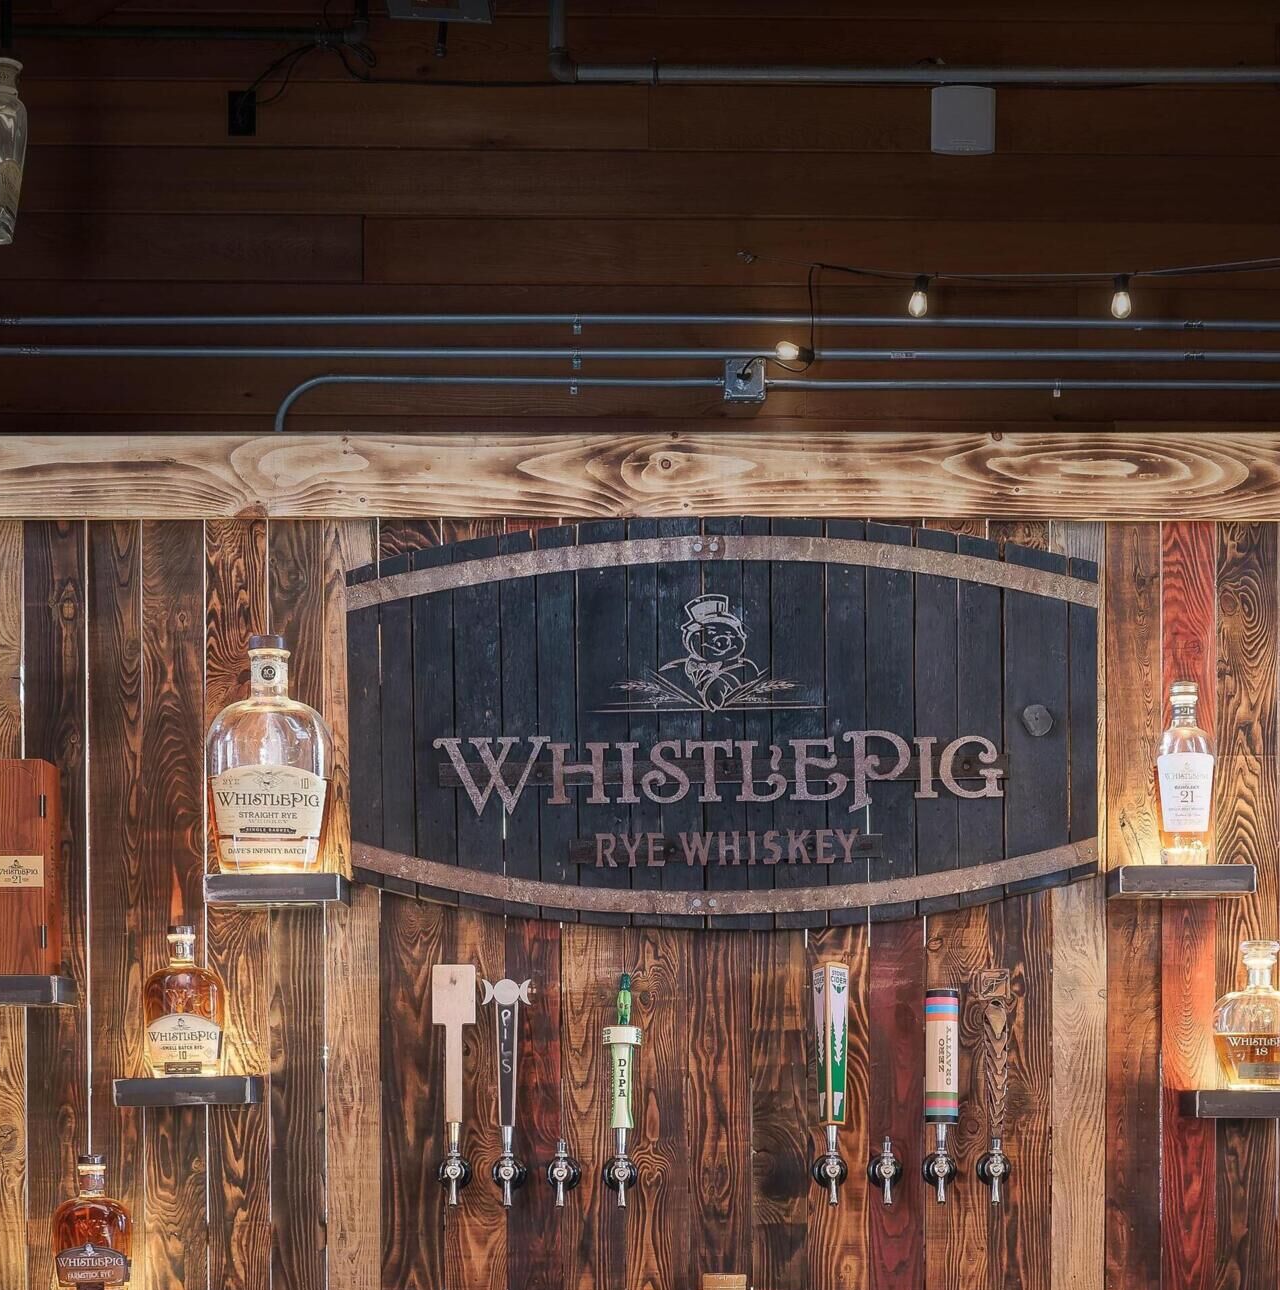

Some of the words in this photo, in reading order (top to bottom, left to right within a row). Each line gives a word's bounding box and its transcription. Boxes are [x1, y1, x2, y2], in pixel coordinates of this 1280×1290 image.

[432, 730, 1006, 817] WHISTLEPIG
[216, 791, 320, 808] WHISTLEPIG
[1180, 791, 1195, 803] 21
[238, 811, 279, 819] STRAIGHT
[252, 847, 283, 855] INFINITY
[595, 833, 666, 869] RYE
[678, 828, 862, 867] WHISKEY
[11, 876, 22, 884] 21
[830, 975, 847, 985] CIDER
[147, 1030, 218, 1043] WHISTLEPIG
[501, 1009, 513, 1074] PILS
[178, 1050, 188, 1060] 10
[1255, 1047, 1269, 1056] 18
[618, 1058, 627, 1098] DIPA
[56, 1256, 125, 1269] WHISTLEPIG
